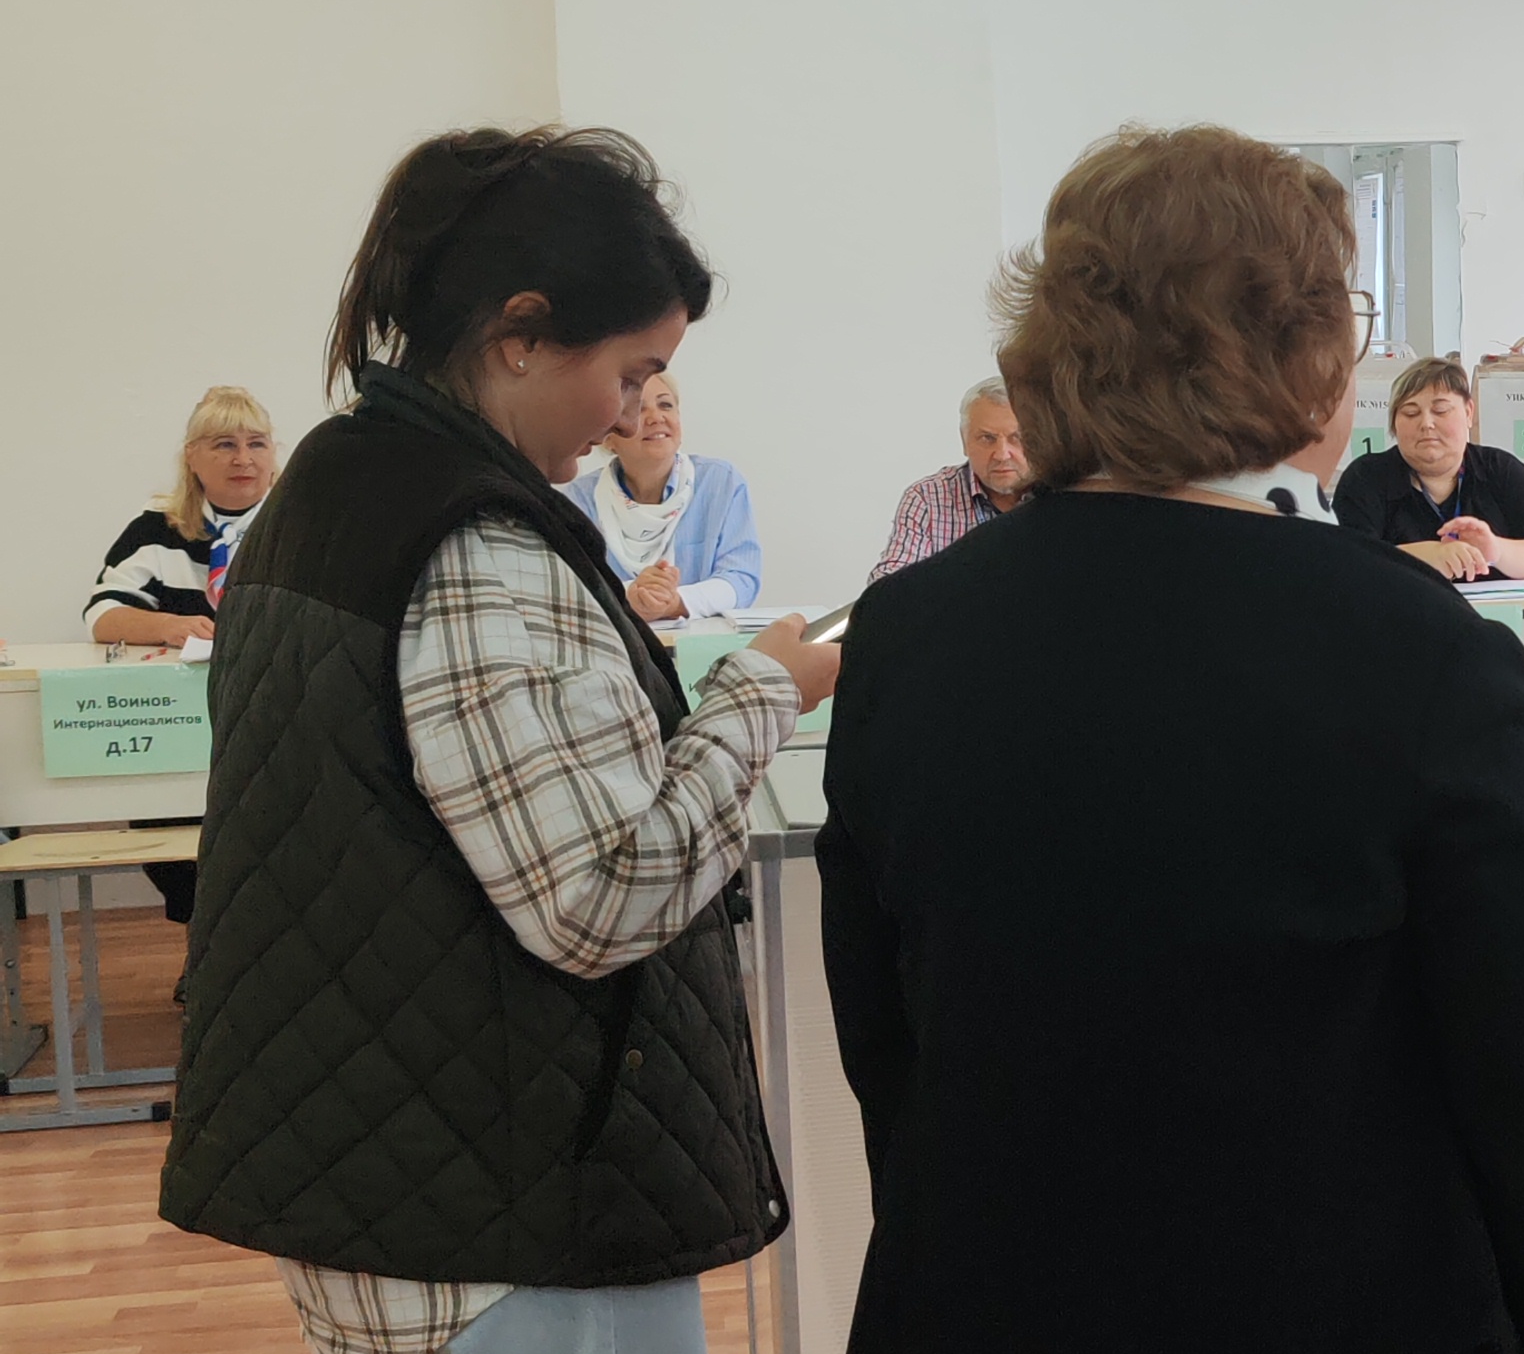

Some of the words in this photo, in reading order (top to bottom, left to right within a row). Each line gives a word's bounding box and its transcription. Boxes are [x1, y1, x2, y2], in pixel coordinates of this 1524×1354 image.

[1362, 436, 1372, 454] 1
[76, 699, 102, 713] ул.
[107, 695, 178, 710] Воинов-
[53, 714, 203, 731] Интернационалистов
[105, 736, 154, 758] д.17
